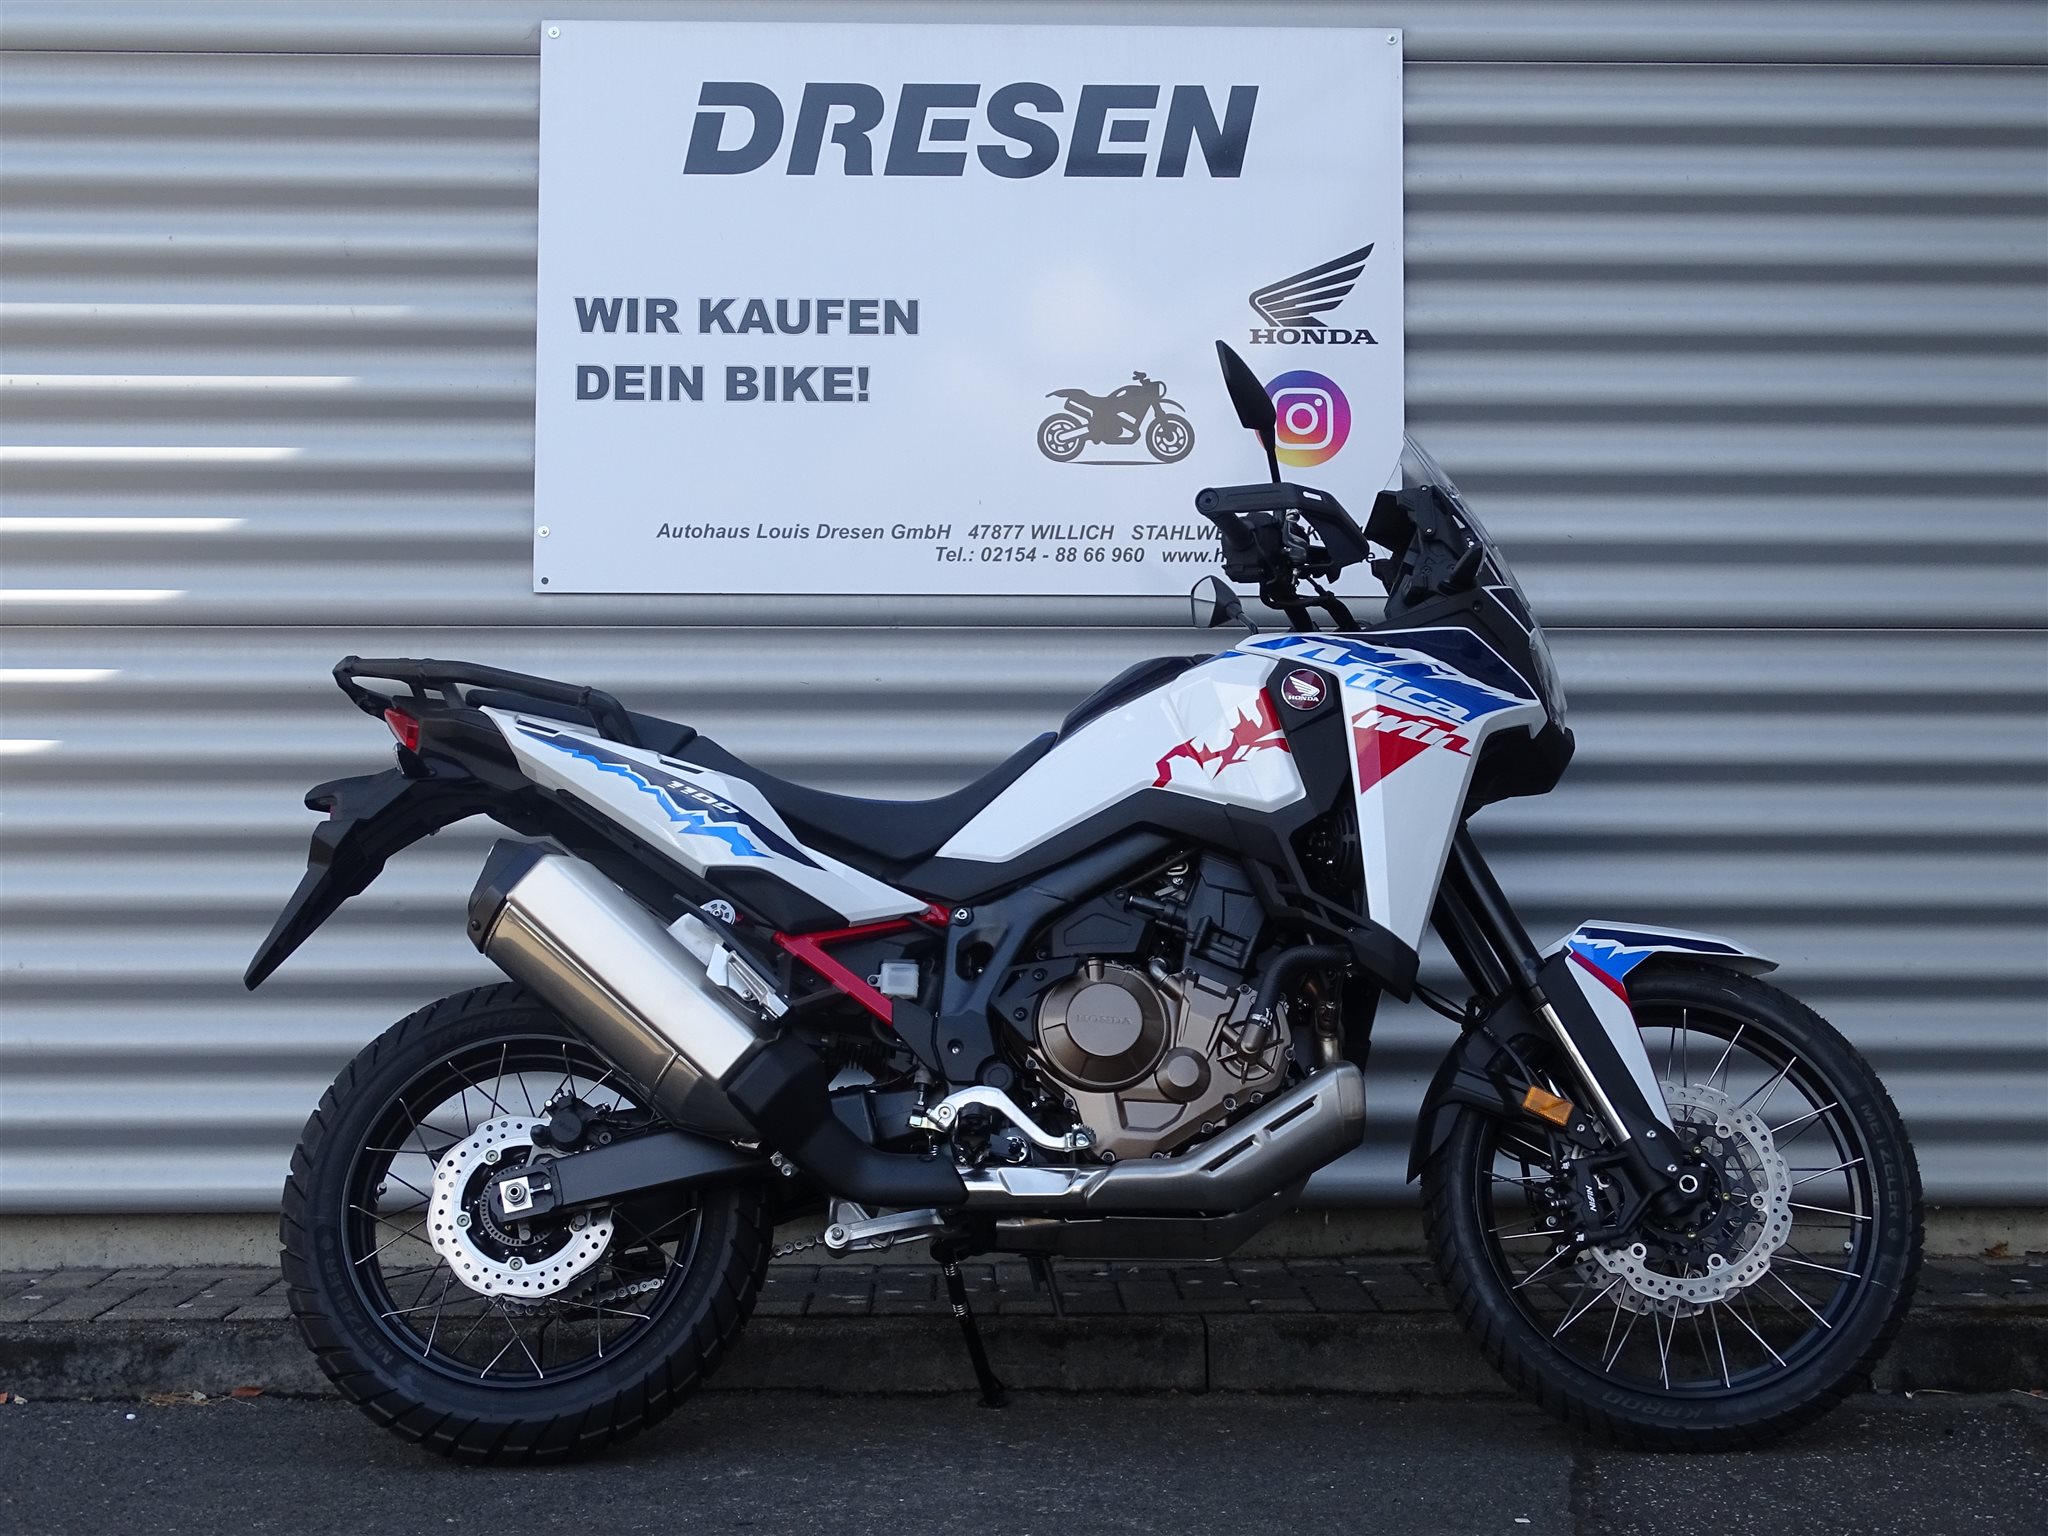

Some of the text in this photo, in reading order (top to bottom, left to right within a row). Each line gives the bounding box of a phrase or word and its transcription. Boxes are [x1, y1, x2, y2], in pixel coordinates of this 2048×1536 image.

[683, 82, 1260, 178] DRESEN
[574, 297, 919, 335] WIR KAUFEN
[1249, 328, 1379, 345] HONDA
[576, 365, 869, 402] DEIN BIKE!
[656, 522, 1223, 541] Autohaus Louis Dresen GmbH 47877 WILLICH STAHLWE
[935, 546, 975, 562] Tel.:
[980, 546, 1037, 563] 02154
[1055, 546, 1078, 563] 88
[1083, 547, 1106, 563] 66
[1111, 547, 1145, 563] 960
[667, 780, 740, 814] 1100
[1076, 1014, 1133, 1025] HONDA
[1860, 1103, 1902, 1219] METZELER
[324, 1258, 395, 1365] METZELER
